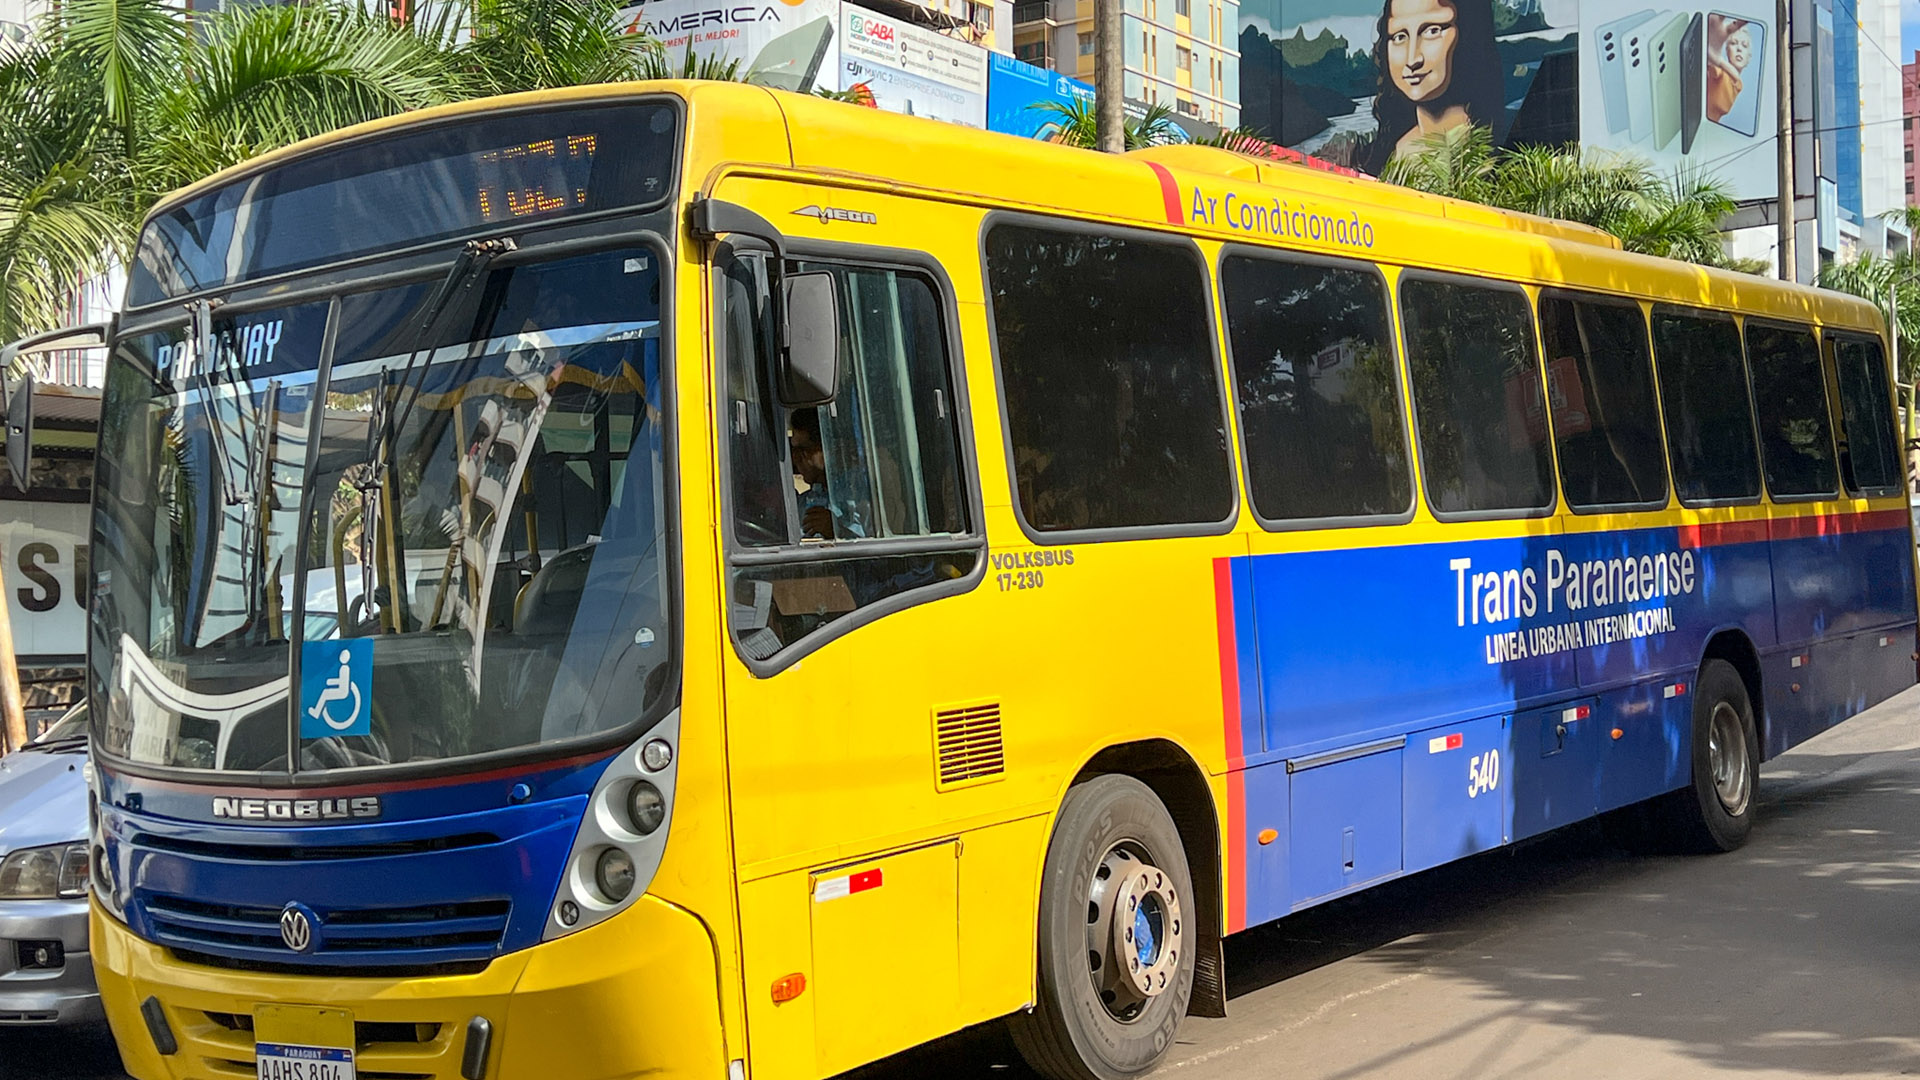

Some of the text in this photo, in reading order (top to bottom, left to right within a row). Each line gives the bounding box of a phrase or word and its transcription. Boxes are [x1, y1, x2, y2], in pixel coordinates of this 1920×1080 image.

[644, 6, 781, 36] AMERICA
[864, 20, 894, 43] GABA
[694, 33, 704, 43] EL
[706, 29, 740, 42] MEJOR!
[864, 67, 888, 82] MAVIC
[1192, 186, 1375, 248] Ar Condicionado
[990, 549, 1075, 570] VOLKSBUS
[996, 570, 1044, 592] 17-230
[1450, 549, 1695, 627] Trans Paranaense
[1485, 607, 1677, 665] LINEA URBANA INTERNACIONAL
[1468, 748, 1499, 799] 540
[212, 796, 381, 820] NEOBUS
[284, 1047, 322, 1060] PARAGUAY
[261, 1059, 303, 1080] AAHS
